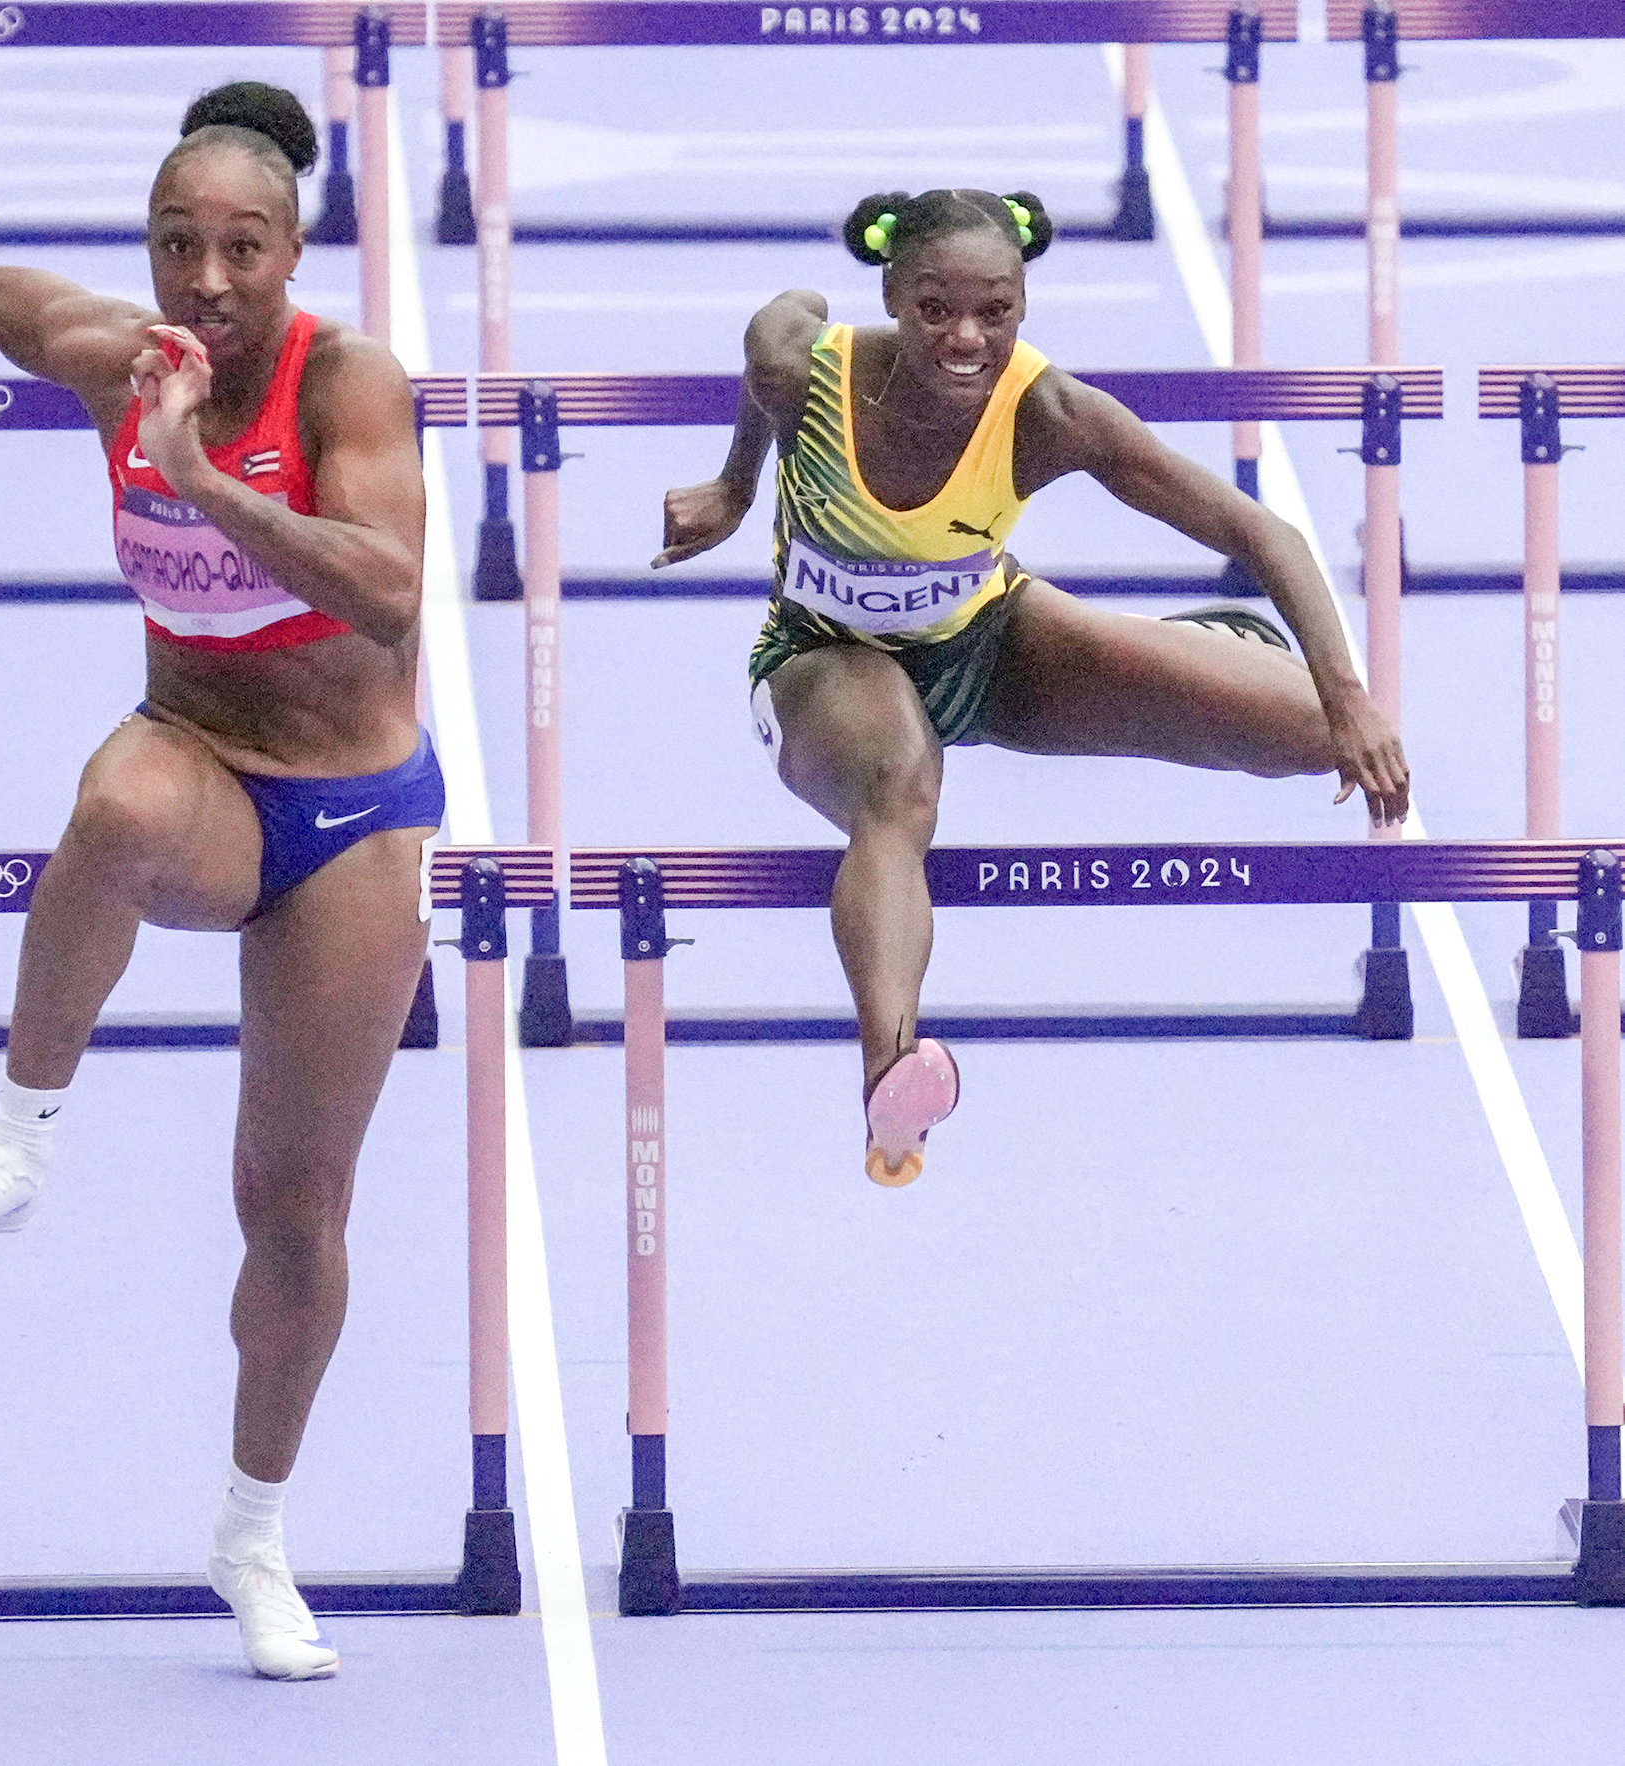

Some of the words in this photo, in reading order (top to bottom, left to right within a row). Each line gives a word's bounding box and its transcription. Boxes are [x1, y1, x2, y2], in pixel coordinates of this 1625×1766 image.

[761, 7, 871, 34] PARIS
[881, 7, 981, 34] 2024
[795, 558, 981, 613] NUGENT
[979, 860, 1110, 890] PARIS
[1131, 857, 1251, 888] 2024
[631, 1140, 659, 1256] MONDO
